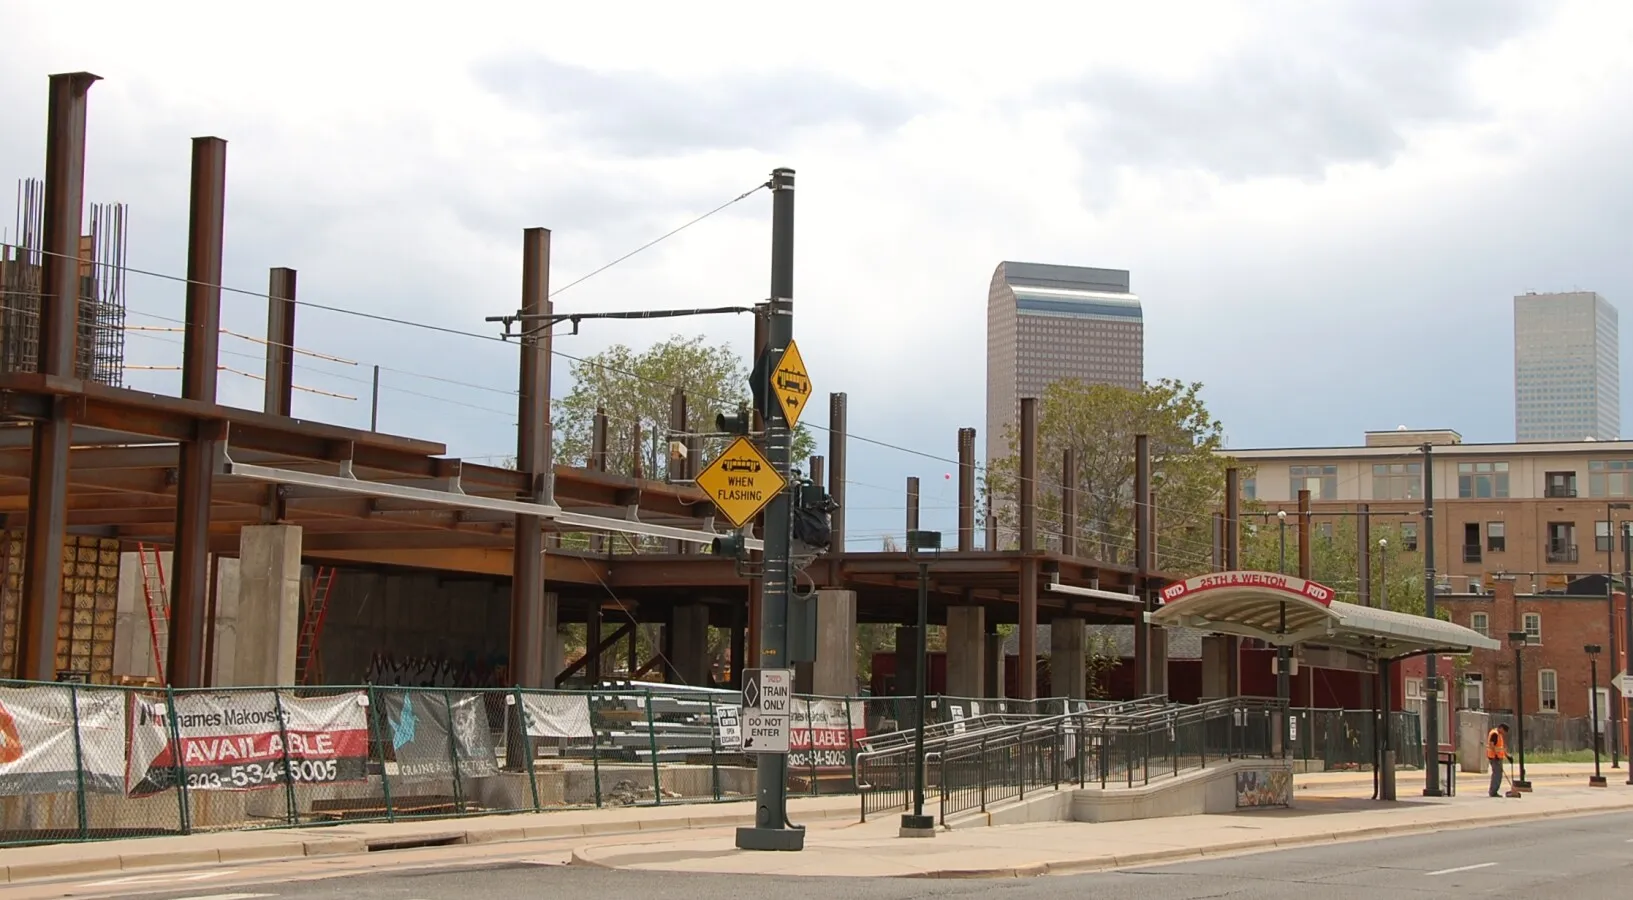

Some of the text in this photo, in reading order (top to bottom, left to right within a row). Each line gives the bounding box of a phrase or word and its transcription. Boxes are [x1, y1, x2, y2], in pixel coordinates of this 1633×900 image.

[727, 476, 754, 487] WHEN
[717, 490, 762, 501] FLASHING
[1200, 575, 1228, 586] 25TH
[1231, 574, 1238, 582] &
[1242, 573, 1287, 588] WELTON
[763, 686, 788, 697] TRAIN
[763, 699, 786, 711] ONLY
[749, 718, 782, 726] DO NOT
[751, 729, 780, 737] ENTER
[790, 730, 847, 746] AVALABLE
[185, 732, 335, 762] AVAILABLE
[187, 759, 337, 788] 303-534-5005
